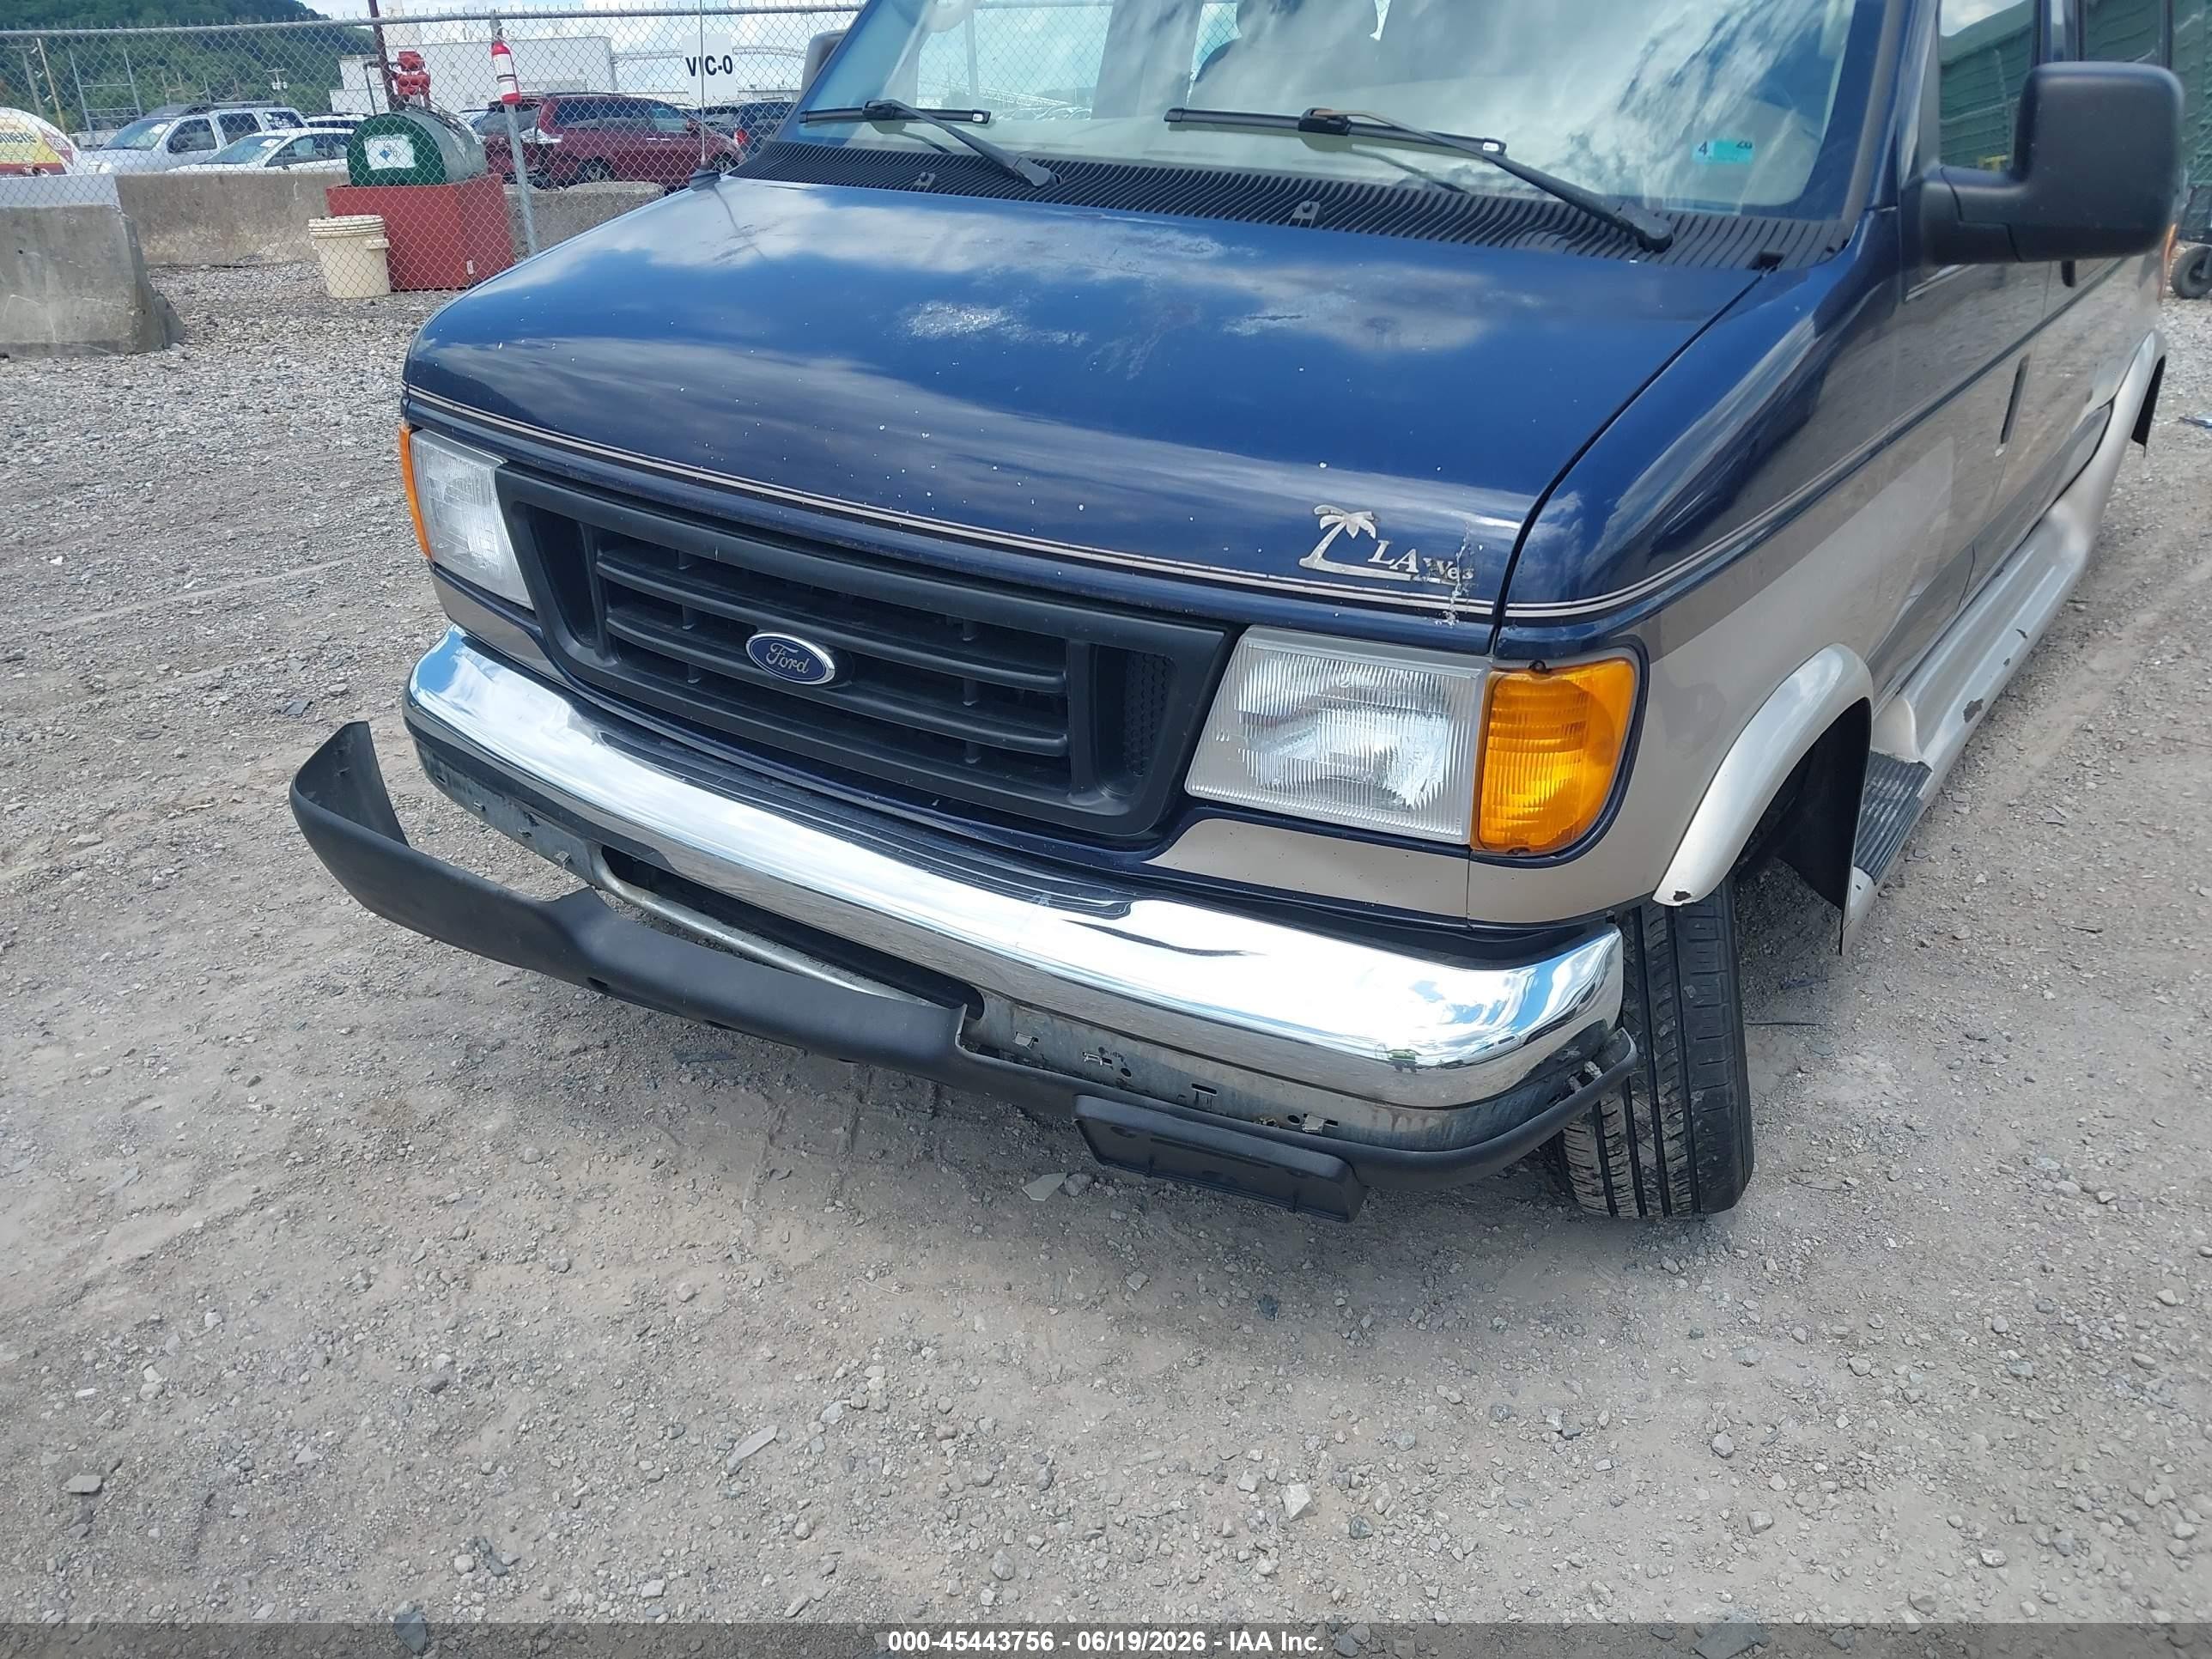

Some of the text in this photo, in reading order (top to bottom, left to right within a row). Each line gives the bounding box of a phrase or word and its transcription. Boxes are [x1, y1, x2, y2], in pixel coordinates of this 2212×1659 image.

[1698, 140, 1708, 156] 4
[1367, 539, 1419, 573] LA
[766, 642, 810, 674] Ford
